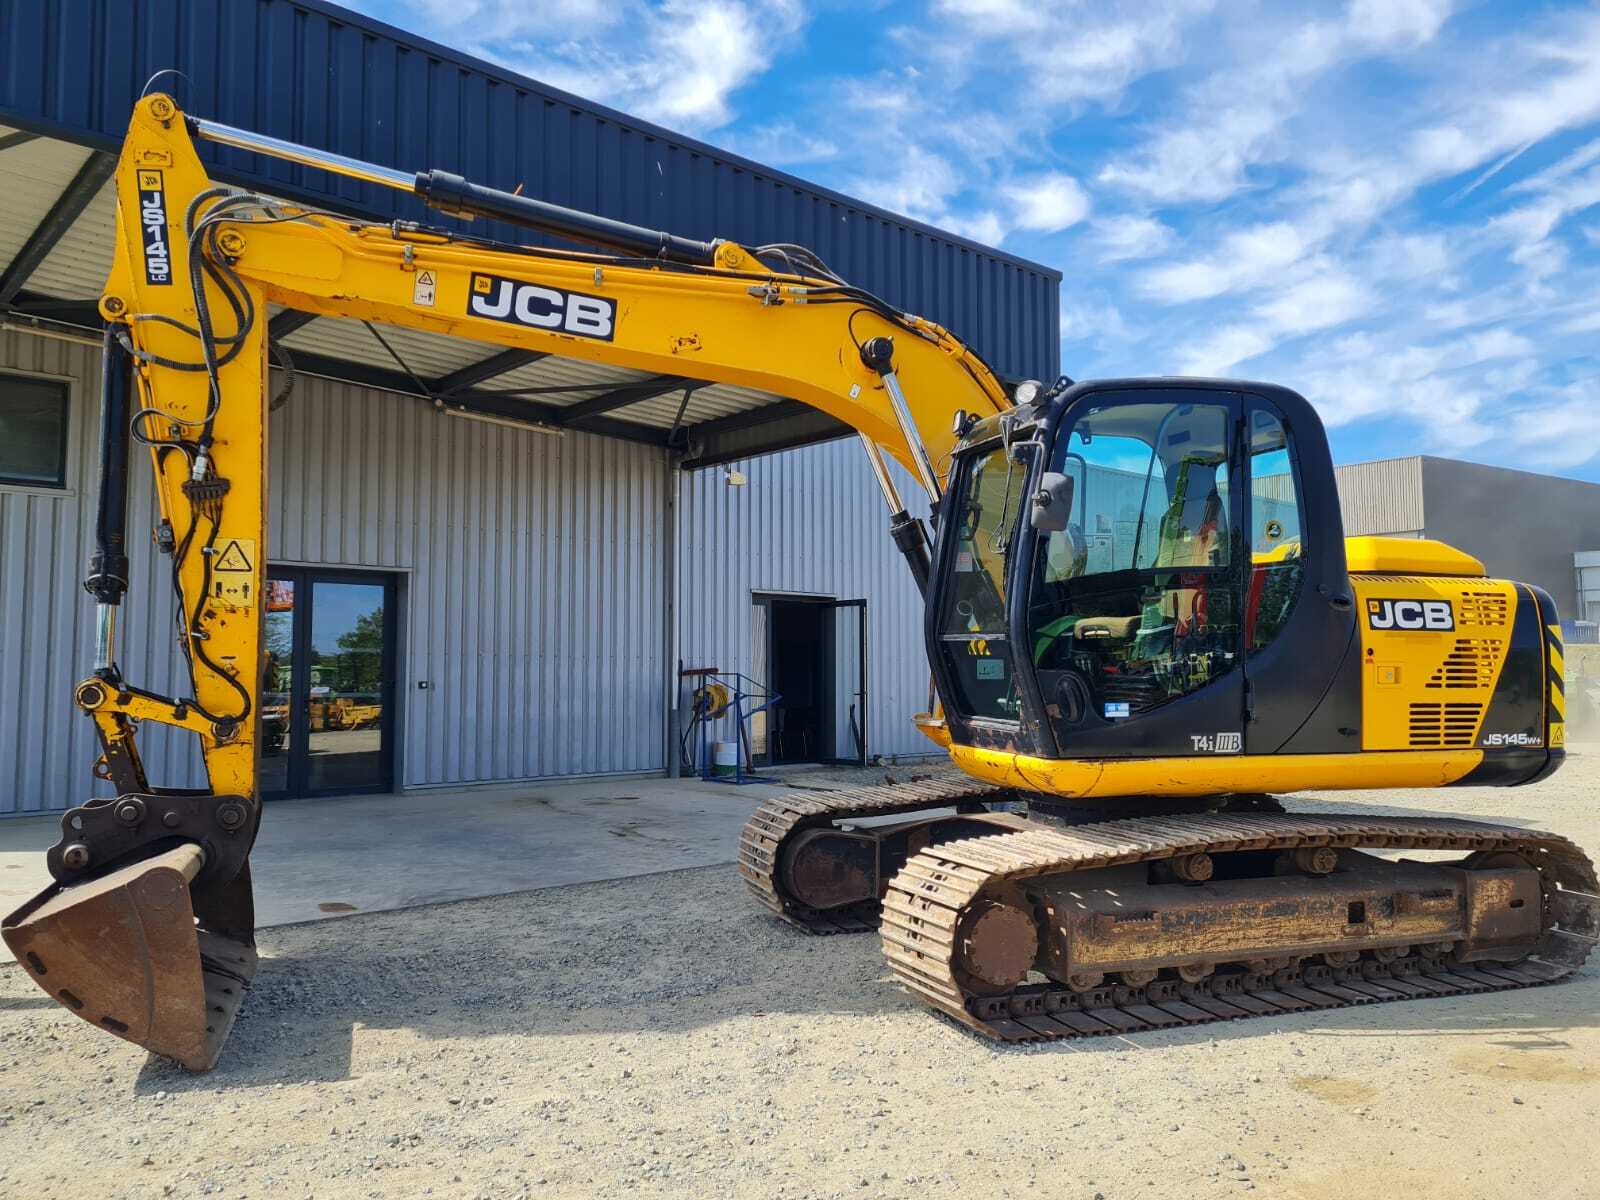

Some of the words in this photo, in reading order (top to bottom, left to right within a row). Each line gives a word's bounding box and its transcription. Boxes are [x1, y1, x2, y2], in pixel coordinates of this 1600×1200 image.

[142, 192, 169, 274] JS145
[472, 280, 612, 337] JCB
[1370, 601, 1453, 629] JCB
